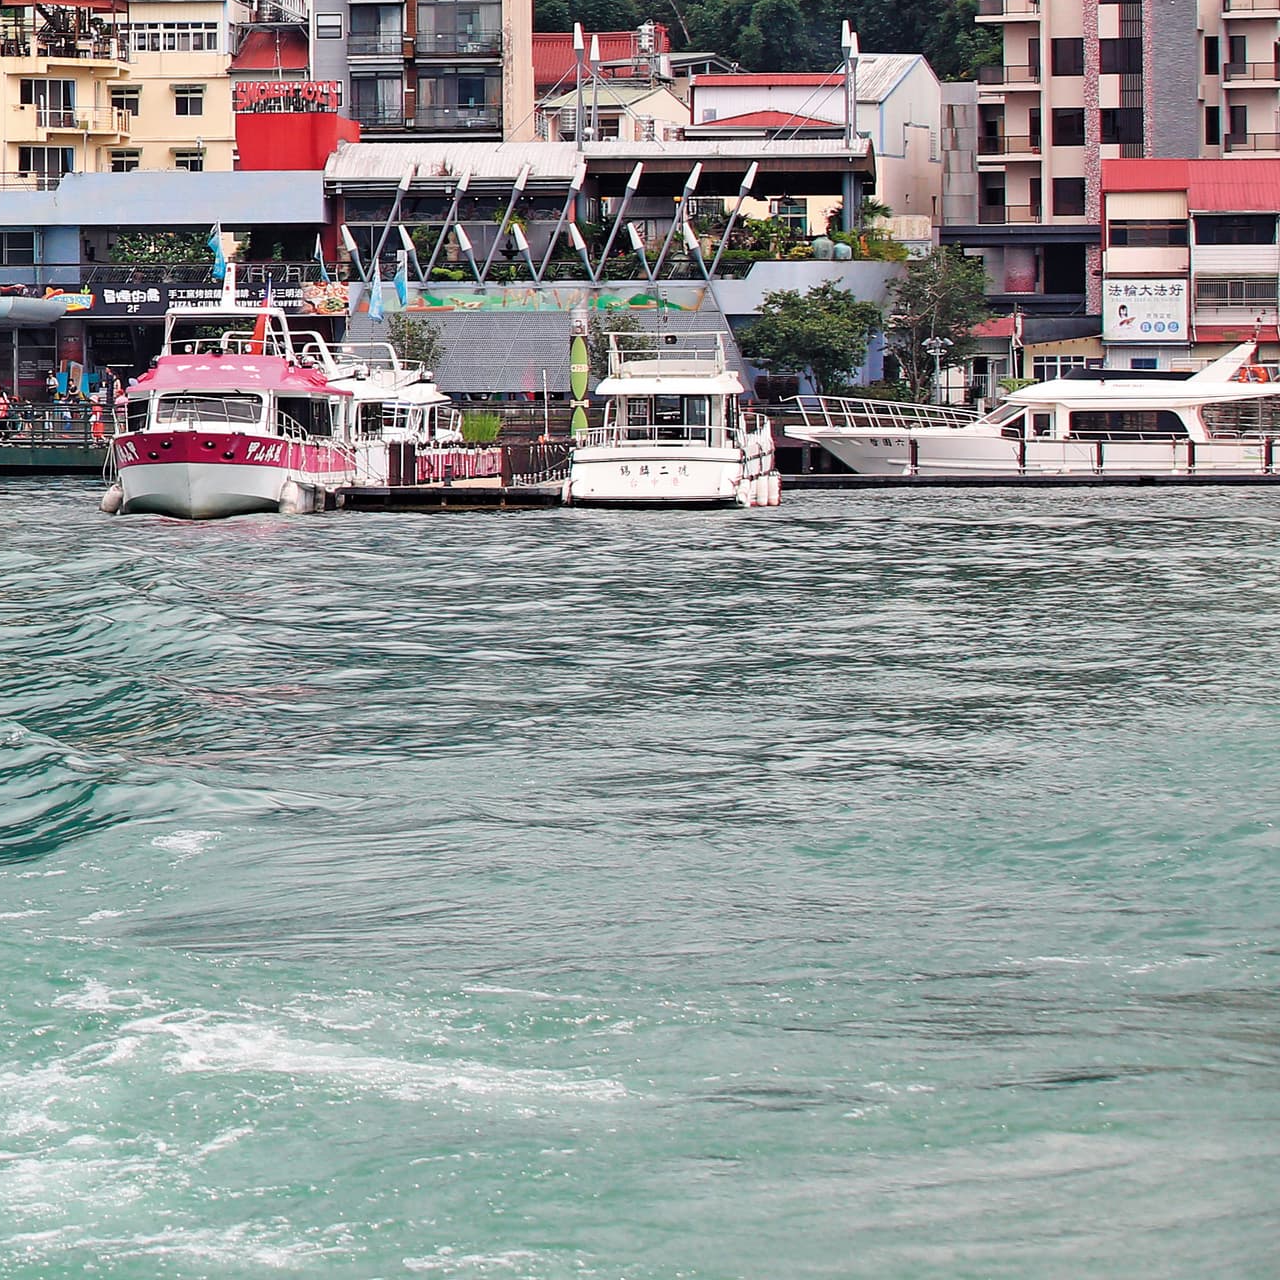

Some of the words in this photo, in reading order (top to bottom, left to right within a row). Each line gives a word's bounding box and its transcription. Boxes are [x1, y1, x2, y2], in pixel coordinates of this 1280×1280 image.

[1108, 283, 1184, 297] 法輪大法好
[127, 304, 140, 313] 2F
